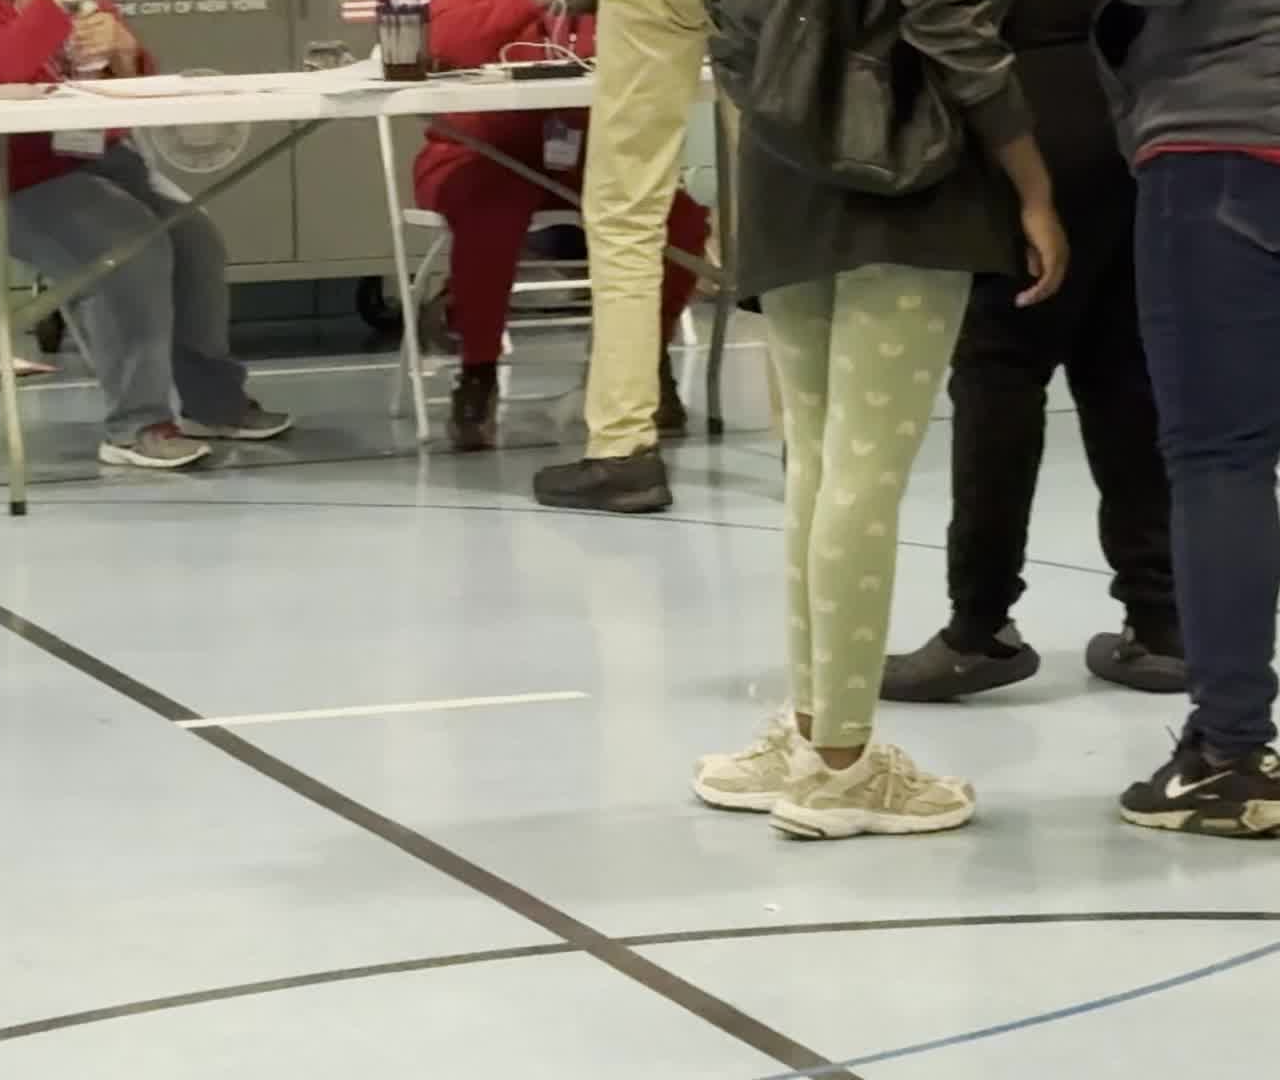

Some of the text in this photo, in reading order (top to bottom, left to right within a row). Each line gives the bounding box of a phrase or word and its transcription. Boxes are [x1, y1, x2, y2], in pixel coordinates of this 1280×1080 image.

[141, 2, 170, 15] CITY
[174, 1, 191, 13] OF
[196, 0, 227, 12] NEW
[231, 0, 267, 11] YORK
